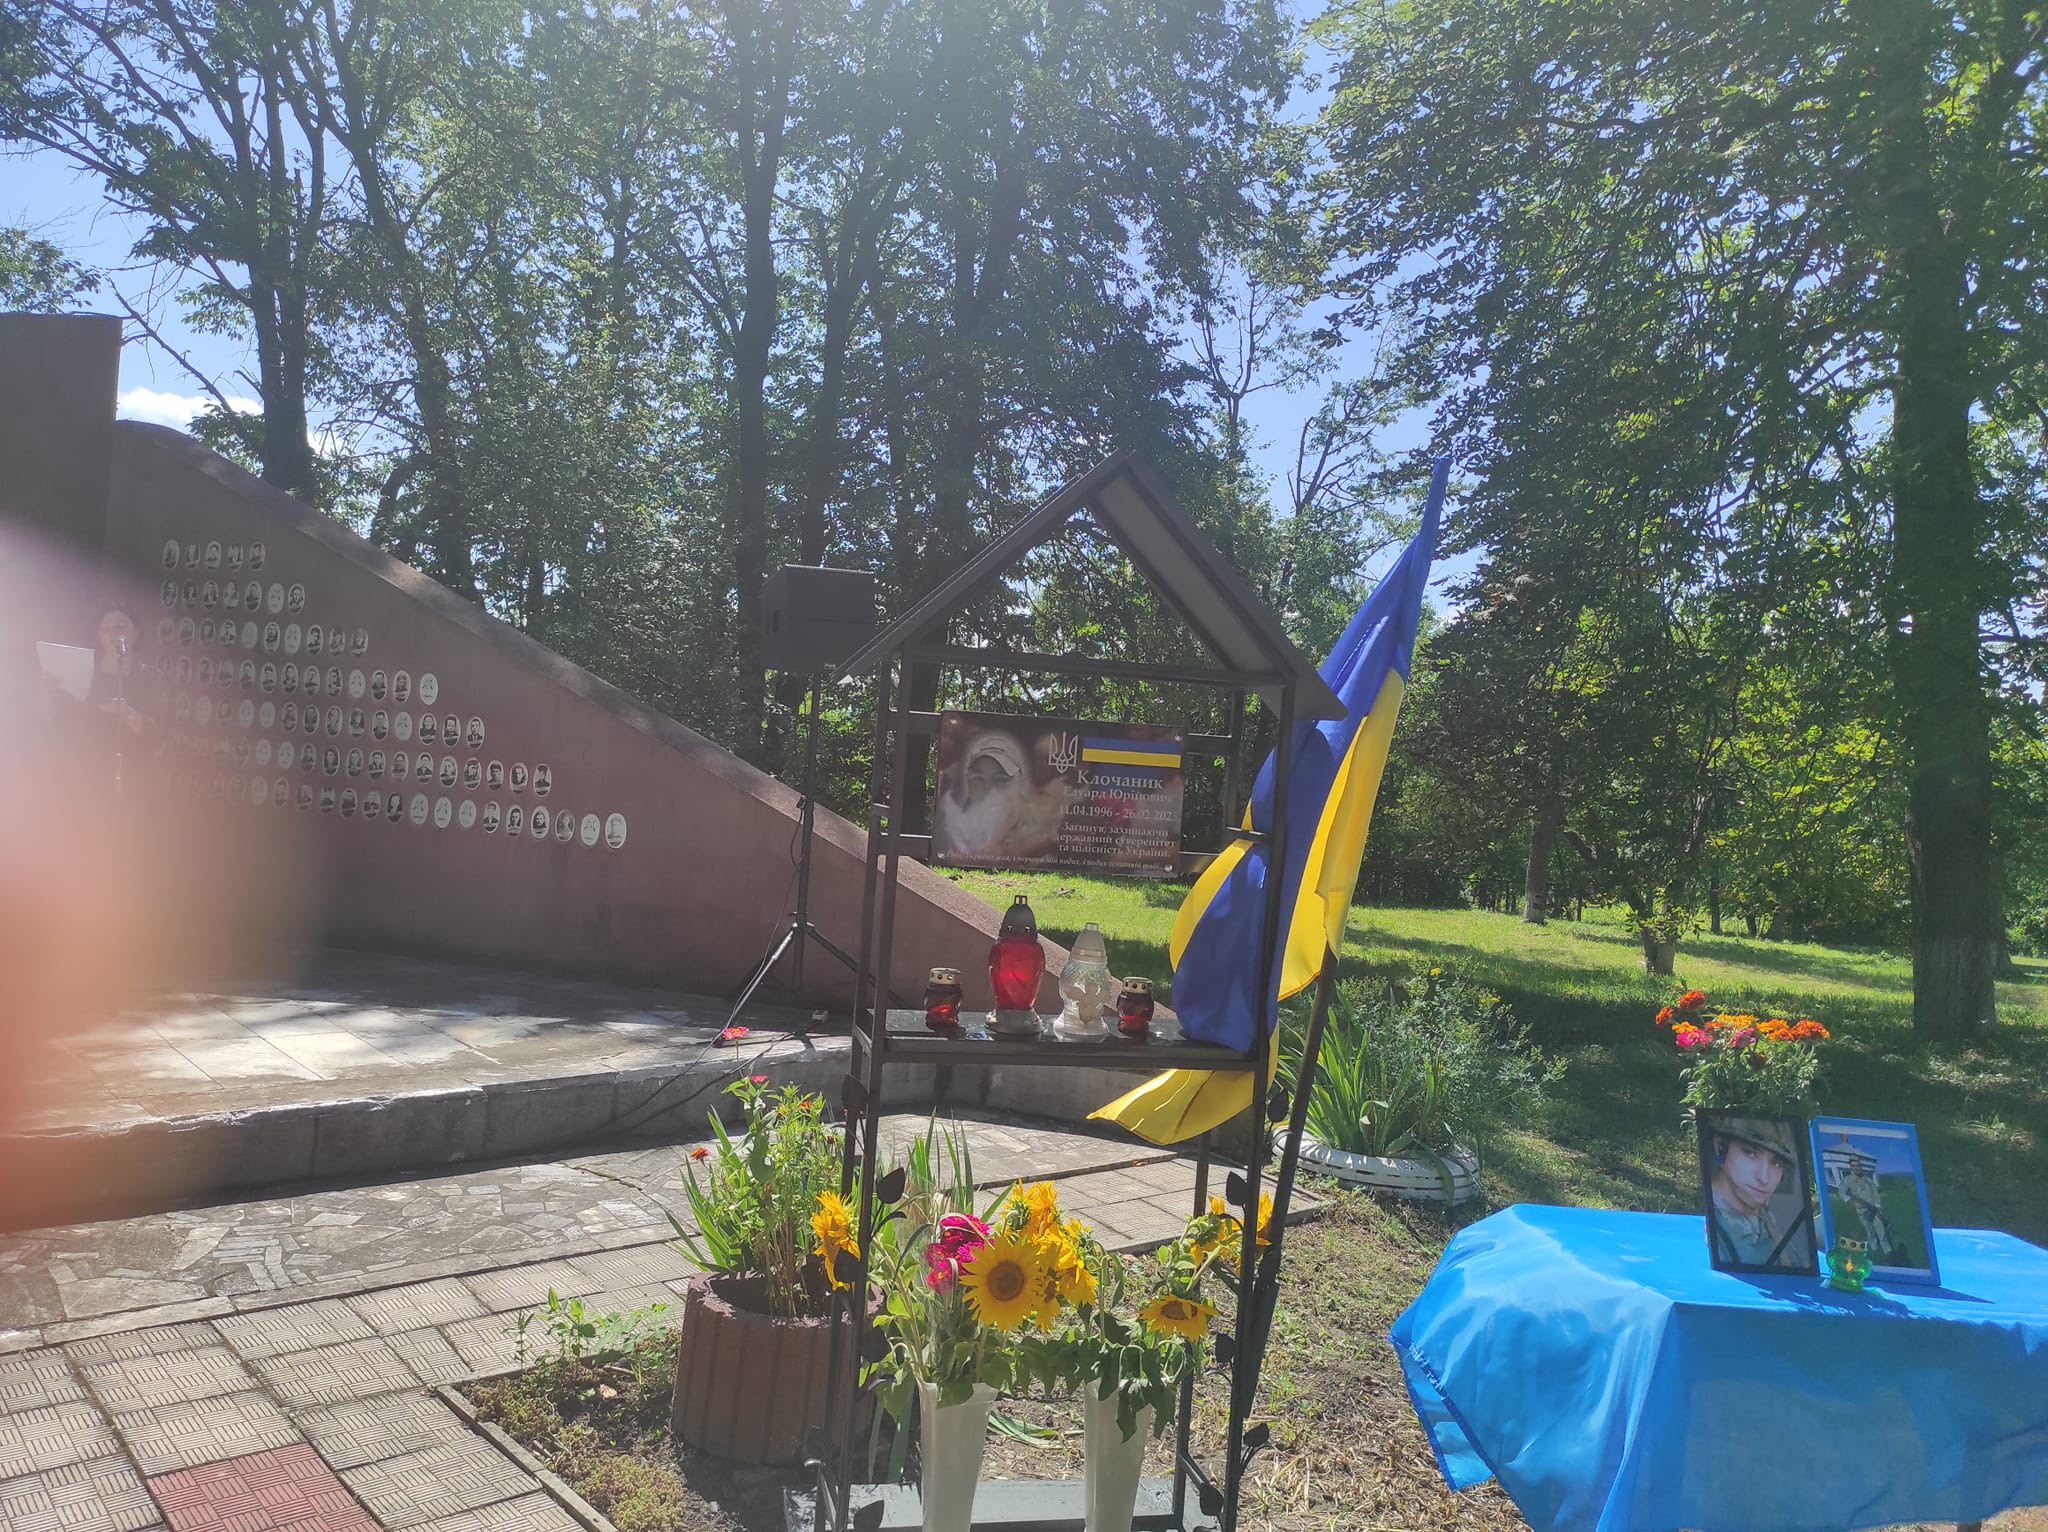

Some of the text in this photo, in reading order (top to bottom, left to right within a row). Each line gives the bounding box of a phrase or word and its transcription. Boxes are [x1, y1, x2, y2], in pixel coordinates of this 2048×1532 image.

[1076, 769, 1163, 789] Клочаник
[1062, 821, 1107, 836] Загинув,
[1059, 843, 1069, 852] та
[1126, 845, 1171, 859] України.
